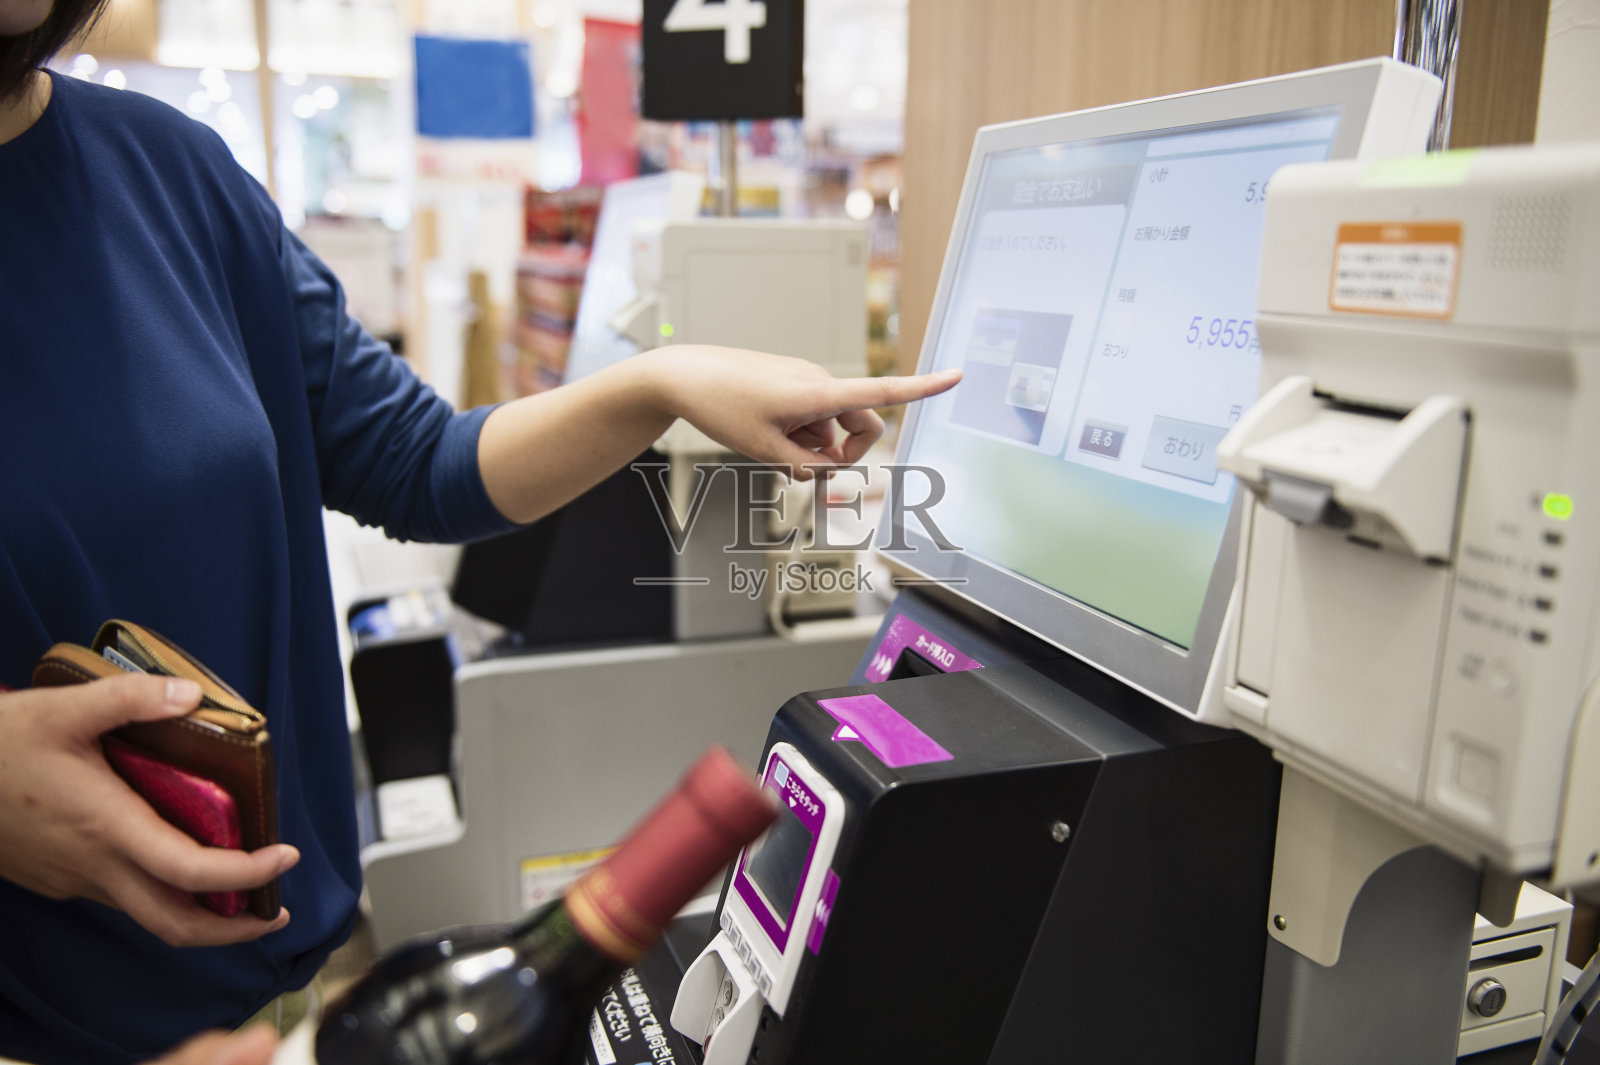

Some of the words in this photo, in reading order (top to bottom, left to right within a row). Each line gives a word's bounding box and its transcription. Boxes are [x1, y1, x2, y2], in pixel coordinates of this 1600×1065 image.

[662, 0, 766, 64] 4
[1103, 343, 1129, 359] おつり
[1090, 428, 1113, 447] 戻る
[1163, 436, 1205, 461] おわり
